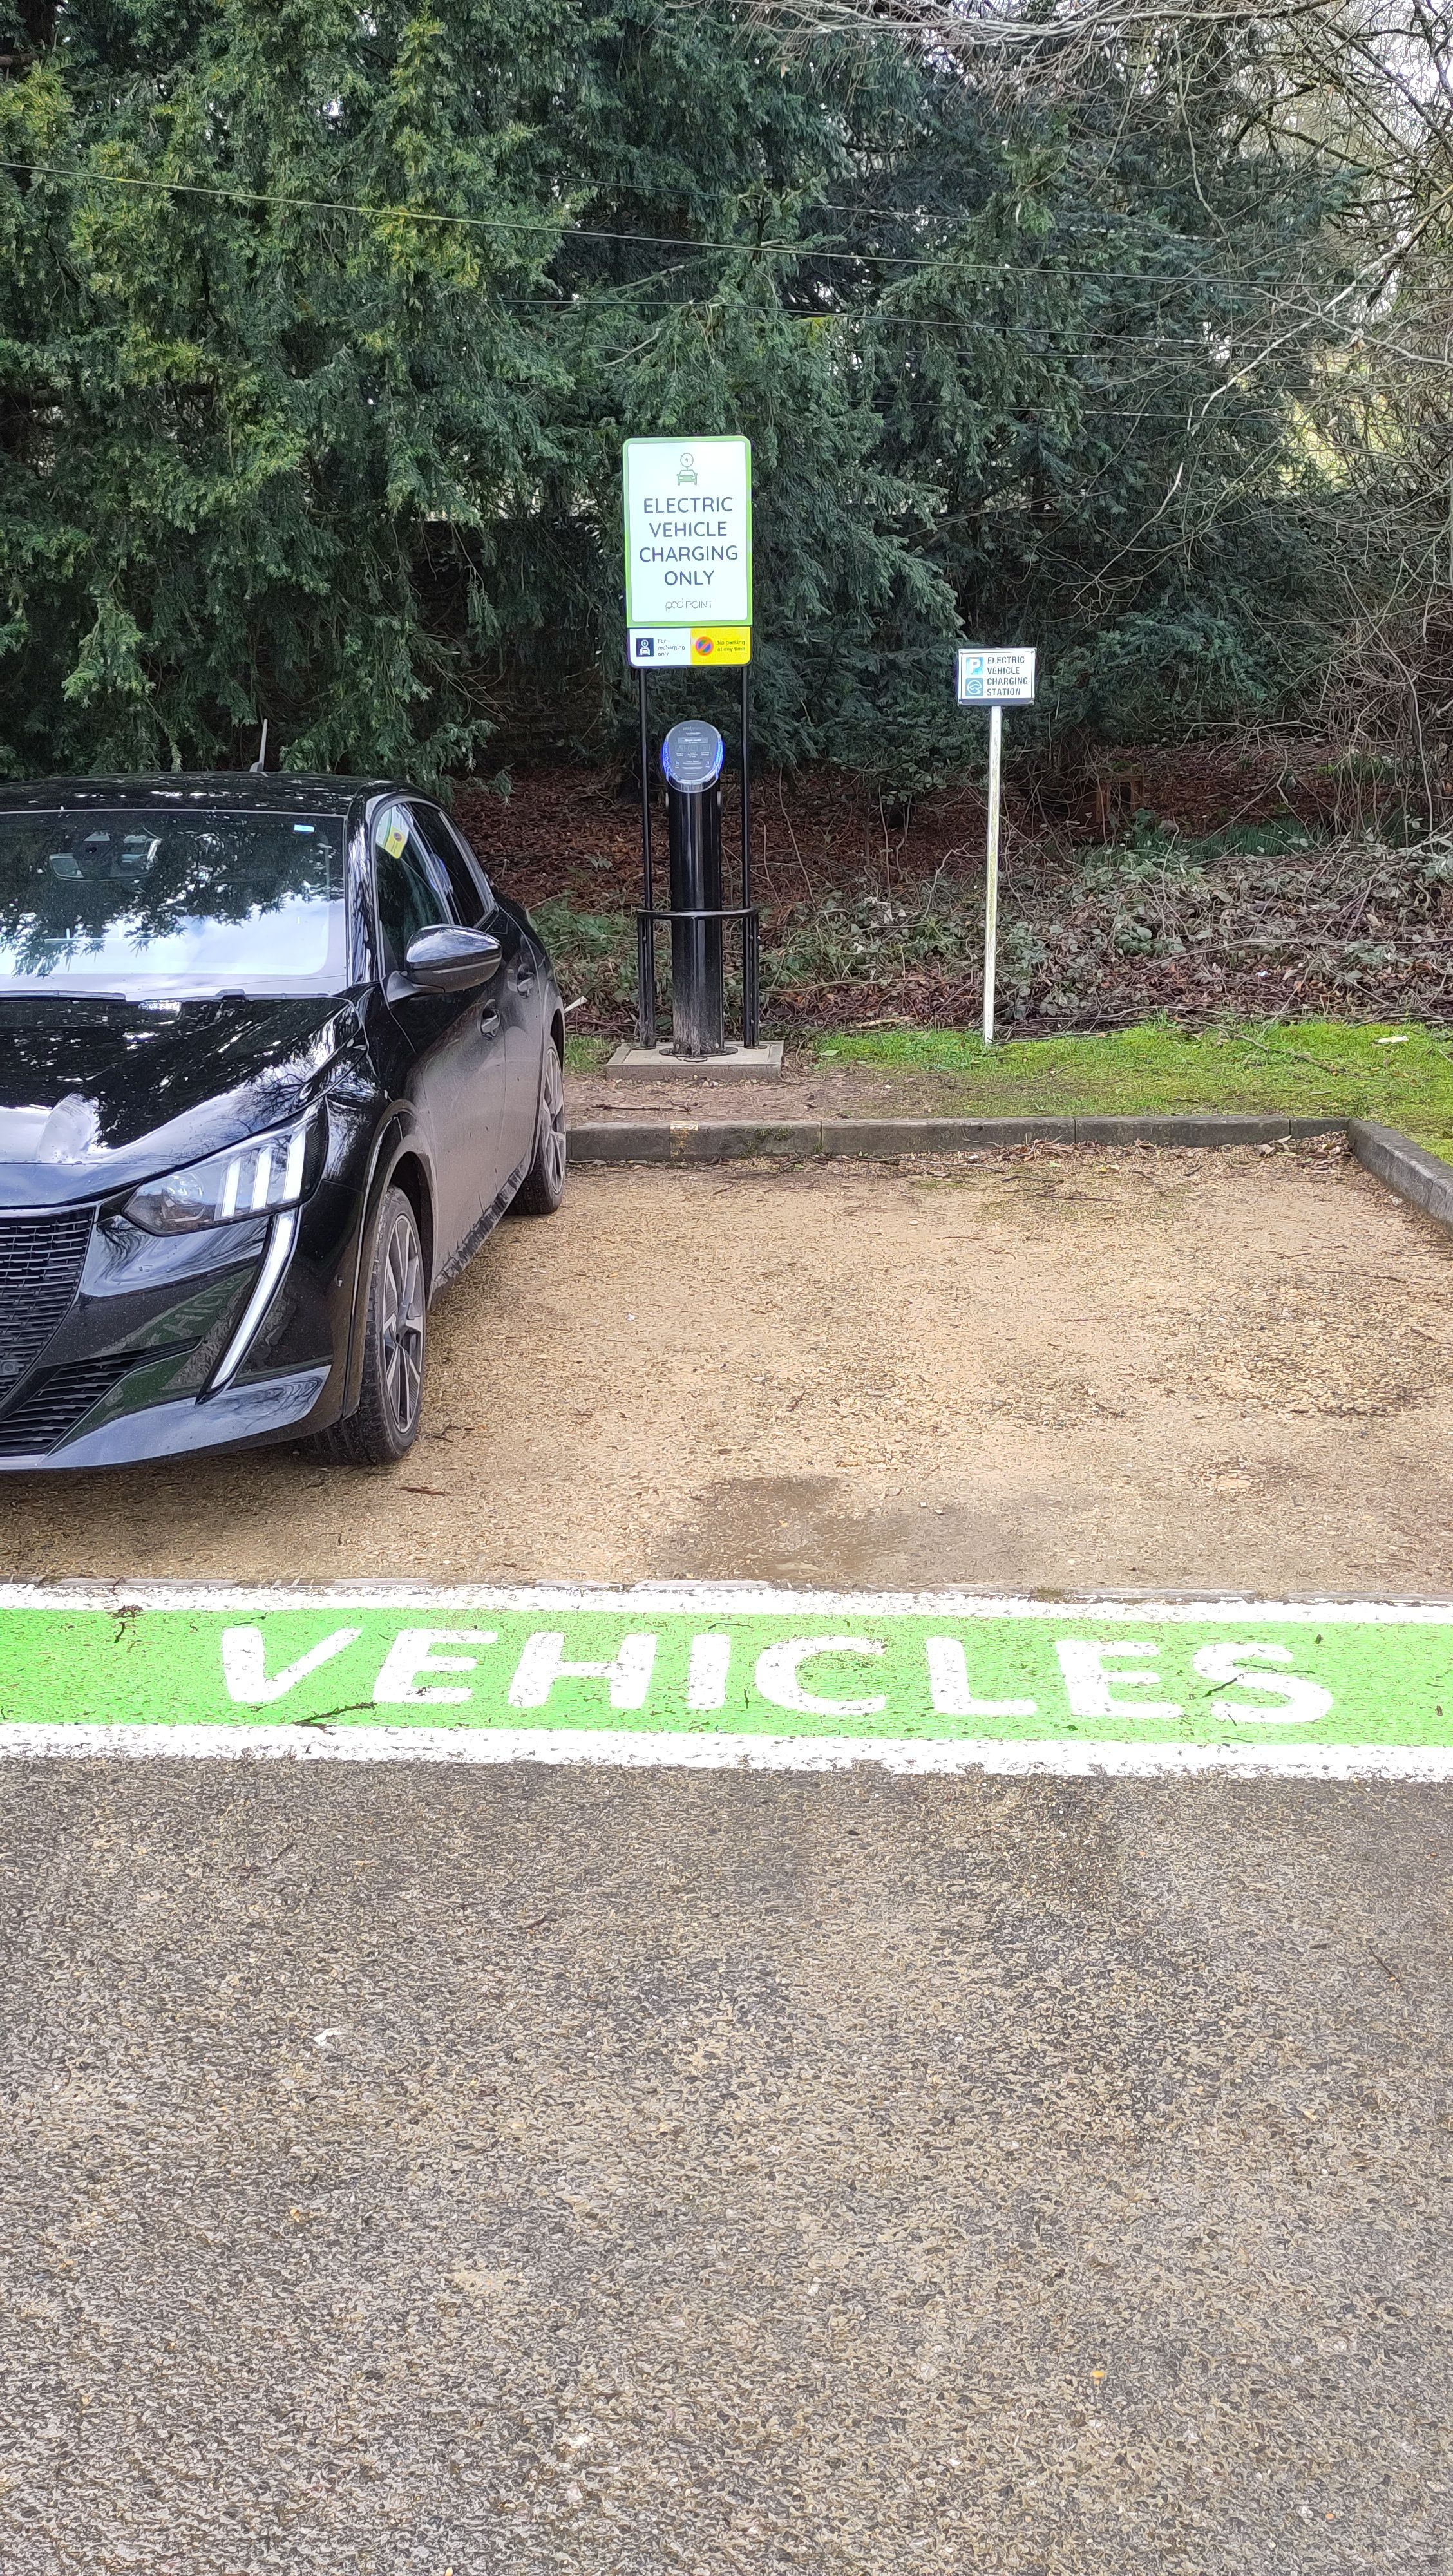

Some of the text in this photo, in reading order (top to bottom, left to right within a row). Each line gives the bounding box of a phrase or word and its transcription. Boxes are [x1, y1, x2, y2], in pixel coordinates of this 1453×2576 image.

[644, 497, 733, 513] ELECTRIC
[649, 521, 728, 537] VEHICLE
[639, 545, 738, 562] CHARGING
[664, 570, 714, 586] ONLY
[685, 600, 713, 609] POINT
[987, 656, 1025, 664] ELECTRIC
[987, 667, 1020, 675] VEHICLE
[987, 677, 1029, 685] CHARGING
[220, 1625, 1335, 1725] VEHICLES
